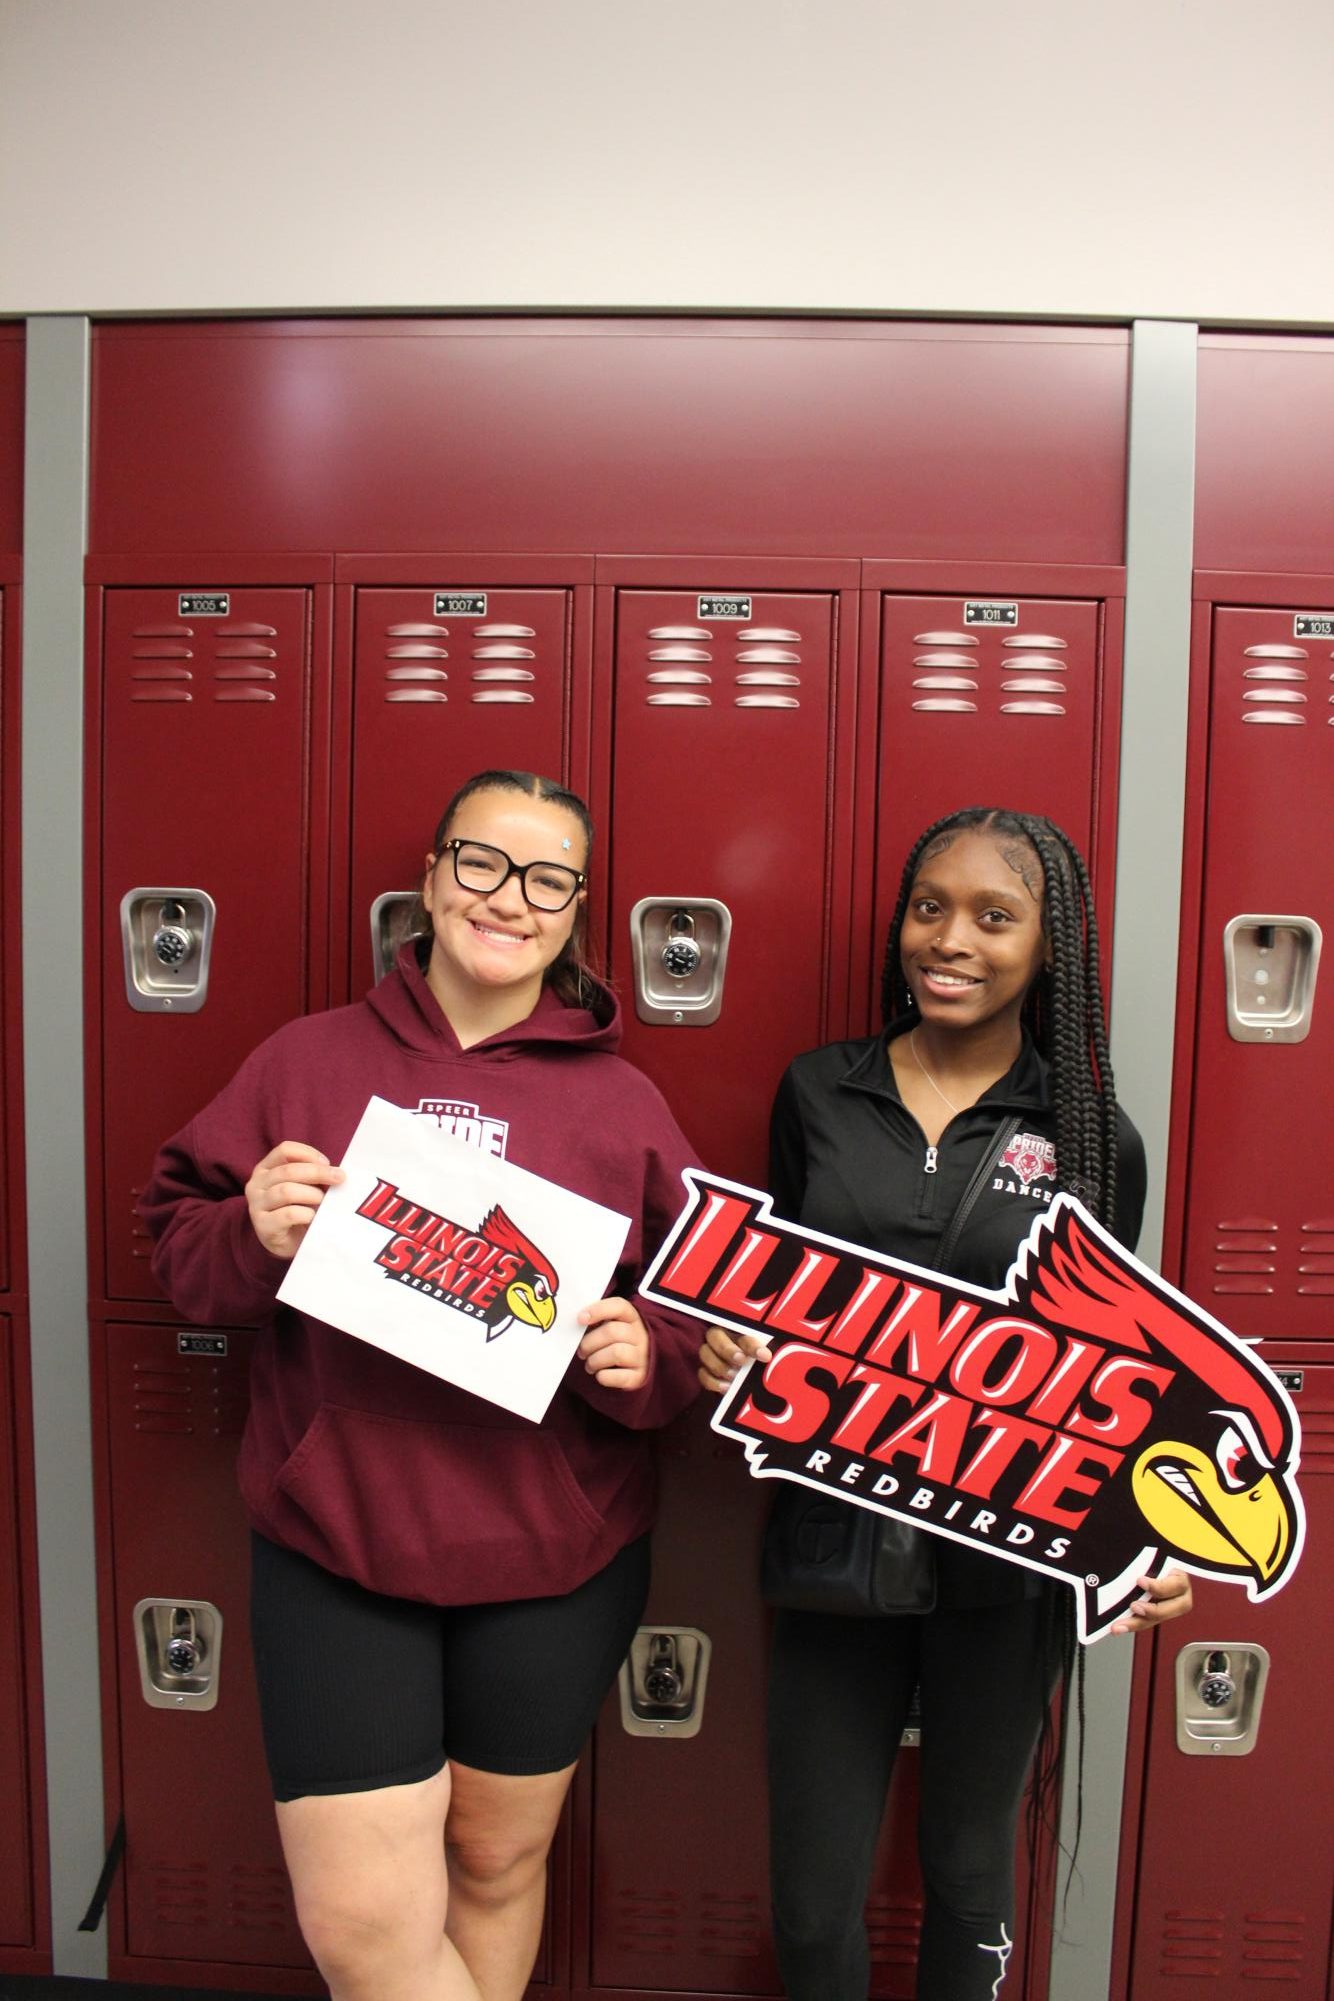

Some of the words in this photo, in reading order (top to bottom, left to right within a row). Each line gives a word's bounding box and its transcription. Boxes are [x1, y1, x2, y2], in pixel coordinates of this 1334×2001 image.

[192, 600, 216, 611] 1005
[448, 600, 473, 611] 1007
[712, 603, 738, 614] 1009
[983, 609, 1000, 620] 1011
[1311, 622, 1331, 633] 1013
[427, 1104, 470, 1116] SPEER
[1011, 1134, 1053, 1158] PRIDE
[992, 1179, 1053, 1203] DANCE
[360, 1182, 525, 1283] ILLINOIS
[378, 1236, 507, 1309] STATE
[400, 1273, 486, 1318] REDBIRDS
[659, 1189, 1176, 1447] ILLINOIS
[735, 1341, 1126, 1531] STATE
[806, 1450, 1072, 1559] REDBIRDS
